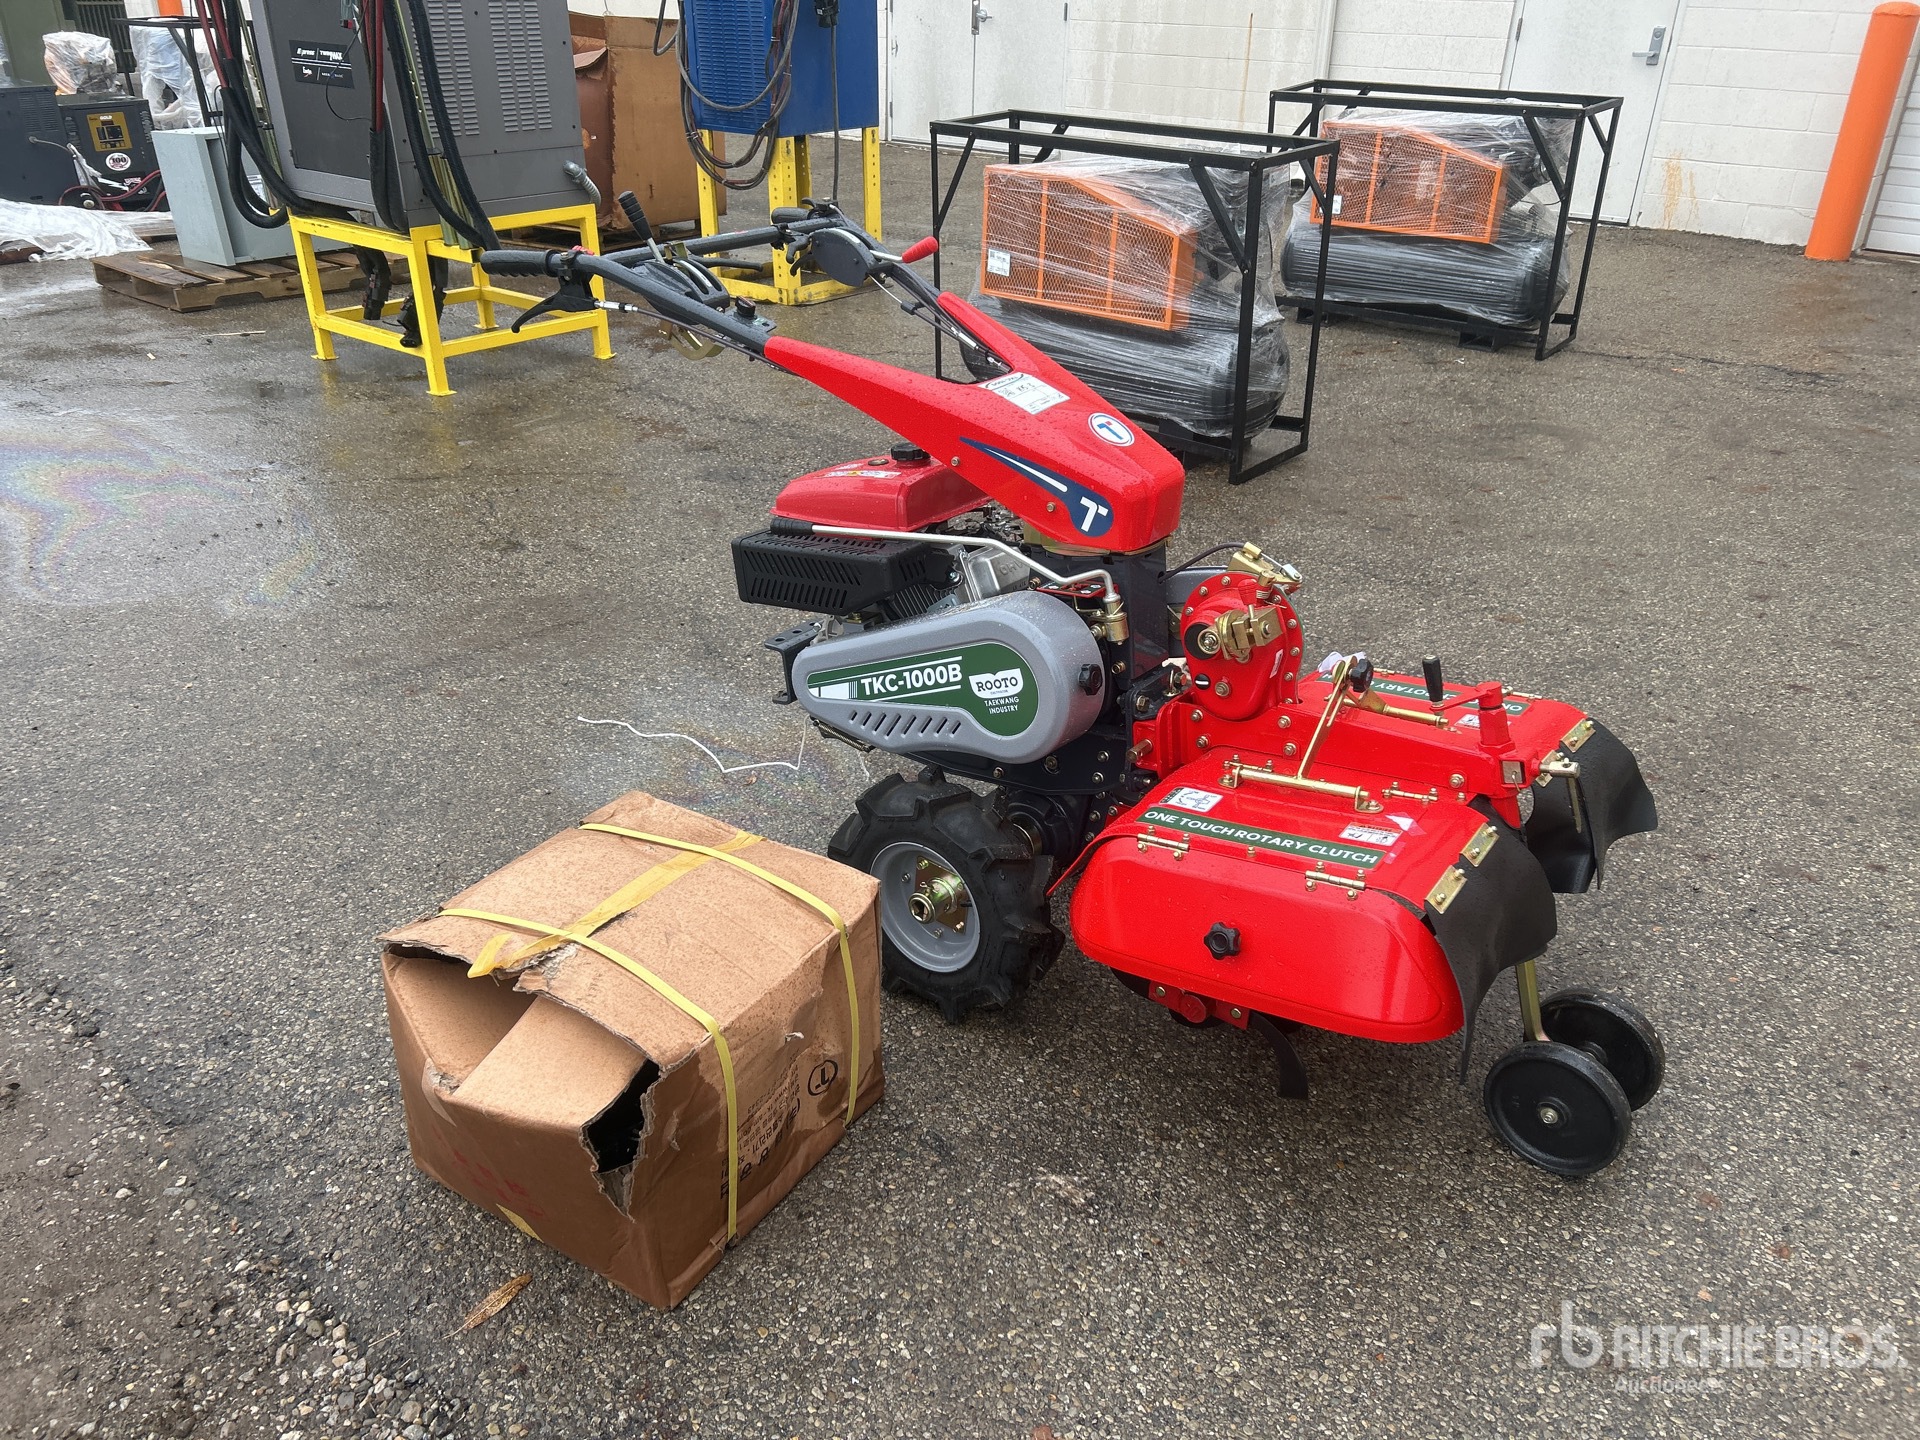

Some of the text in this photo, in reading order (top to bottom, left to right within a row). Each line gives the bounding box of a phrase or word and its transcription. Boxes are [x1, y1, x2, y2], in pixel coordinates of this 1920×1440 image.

[860, 663, 963, 696] TKC-1000B
[975, 676, 1018, 692] ROOTO
[983, 696, 1020, 707] TAEKWANG
[988, 705, 1019, 715] INDUSTRY
[1144, 811, 1379, 864] ONE TOUCH ROTARY CLUTCH
